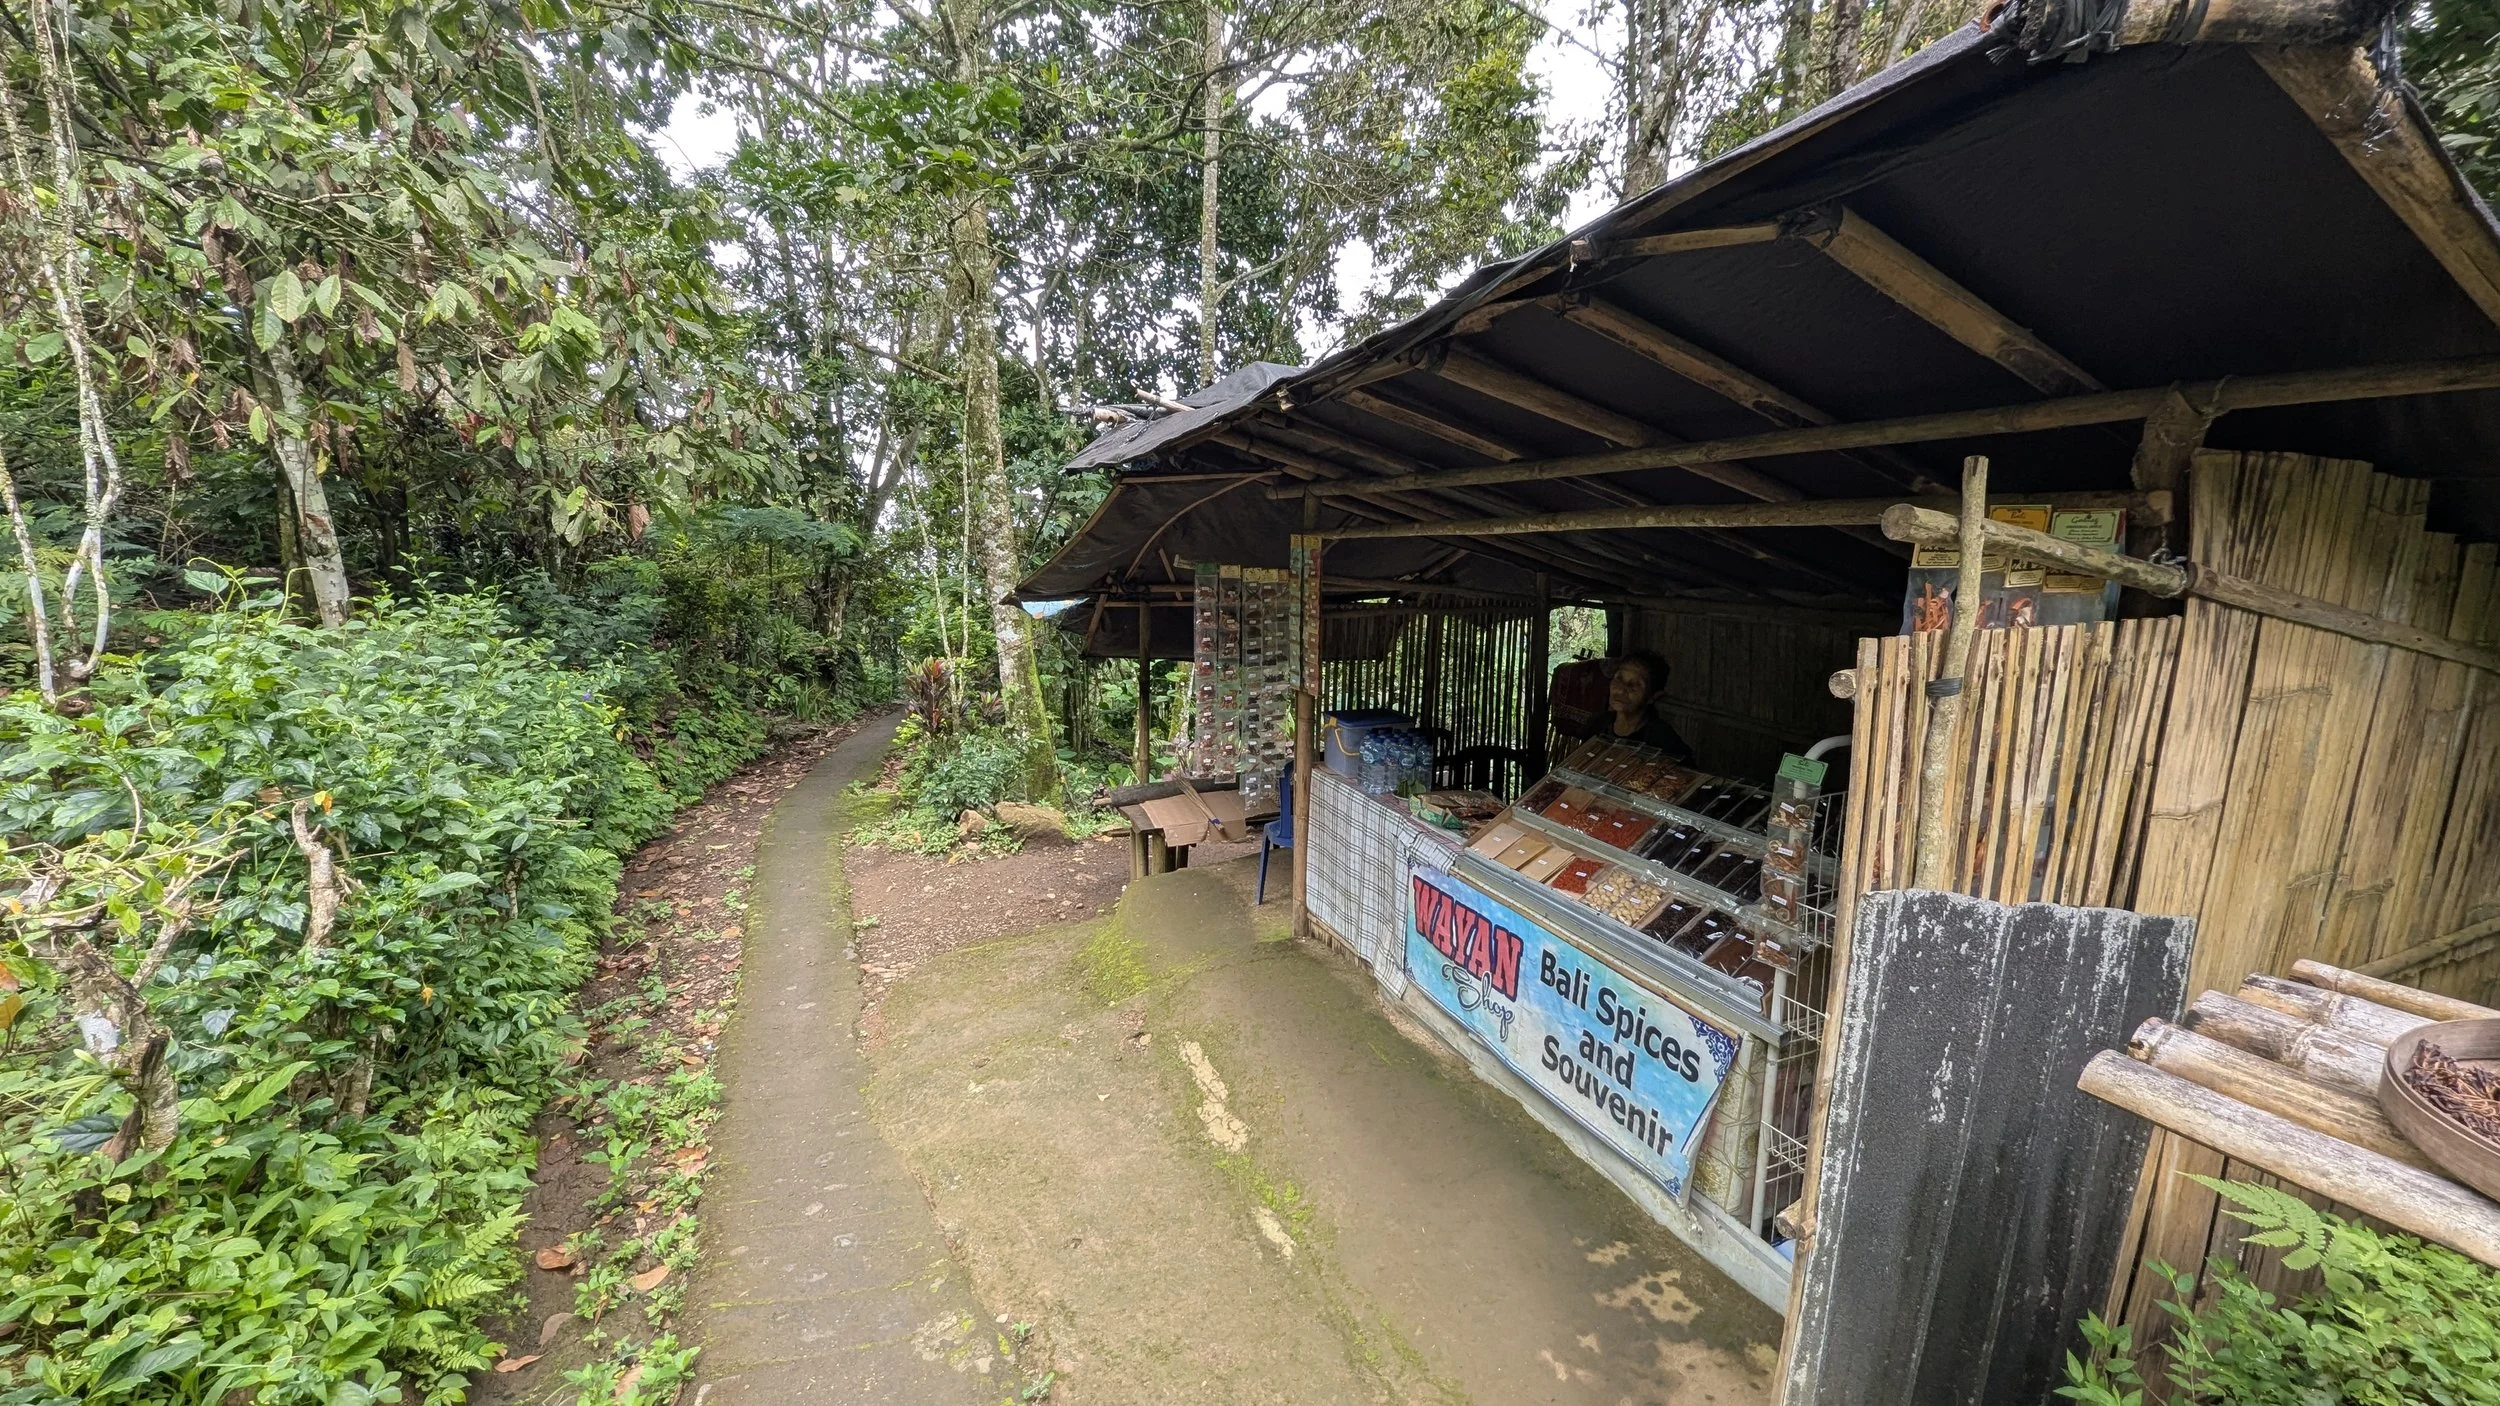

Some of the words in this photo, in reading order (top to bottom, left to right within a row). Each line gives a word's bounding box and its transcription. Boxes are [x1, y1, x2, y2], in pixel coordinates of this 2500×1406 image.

[1413, 875, 1523, 1002] WAYAN
[1442, 963, 1515, 1042] Shop
[1540, 949, 1590, 1010] Bali
[1596, 986, 1700, 1083] Spices
[1579, 1029, 1635, 1091] and
[1541, 1034, 1673, 1157] Souvenir
